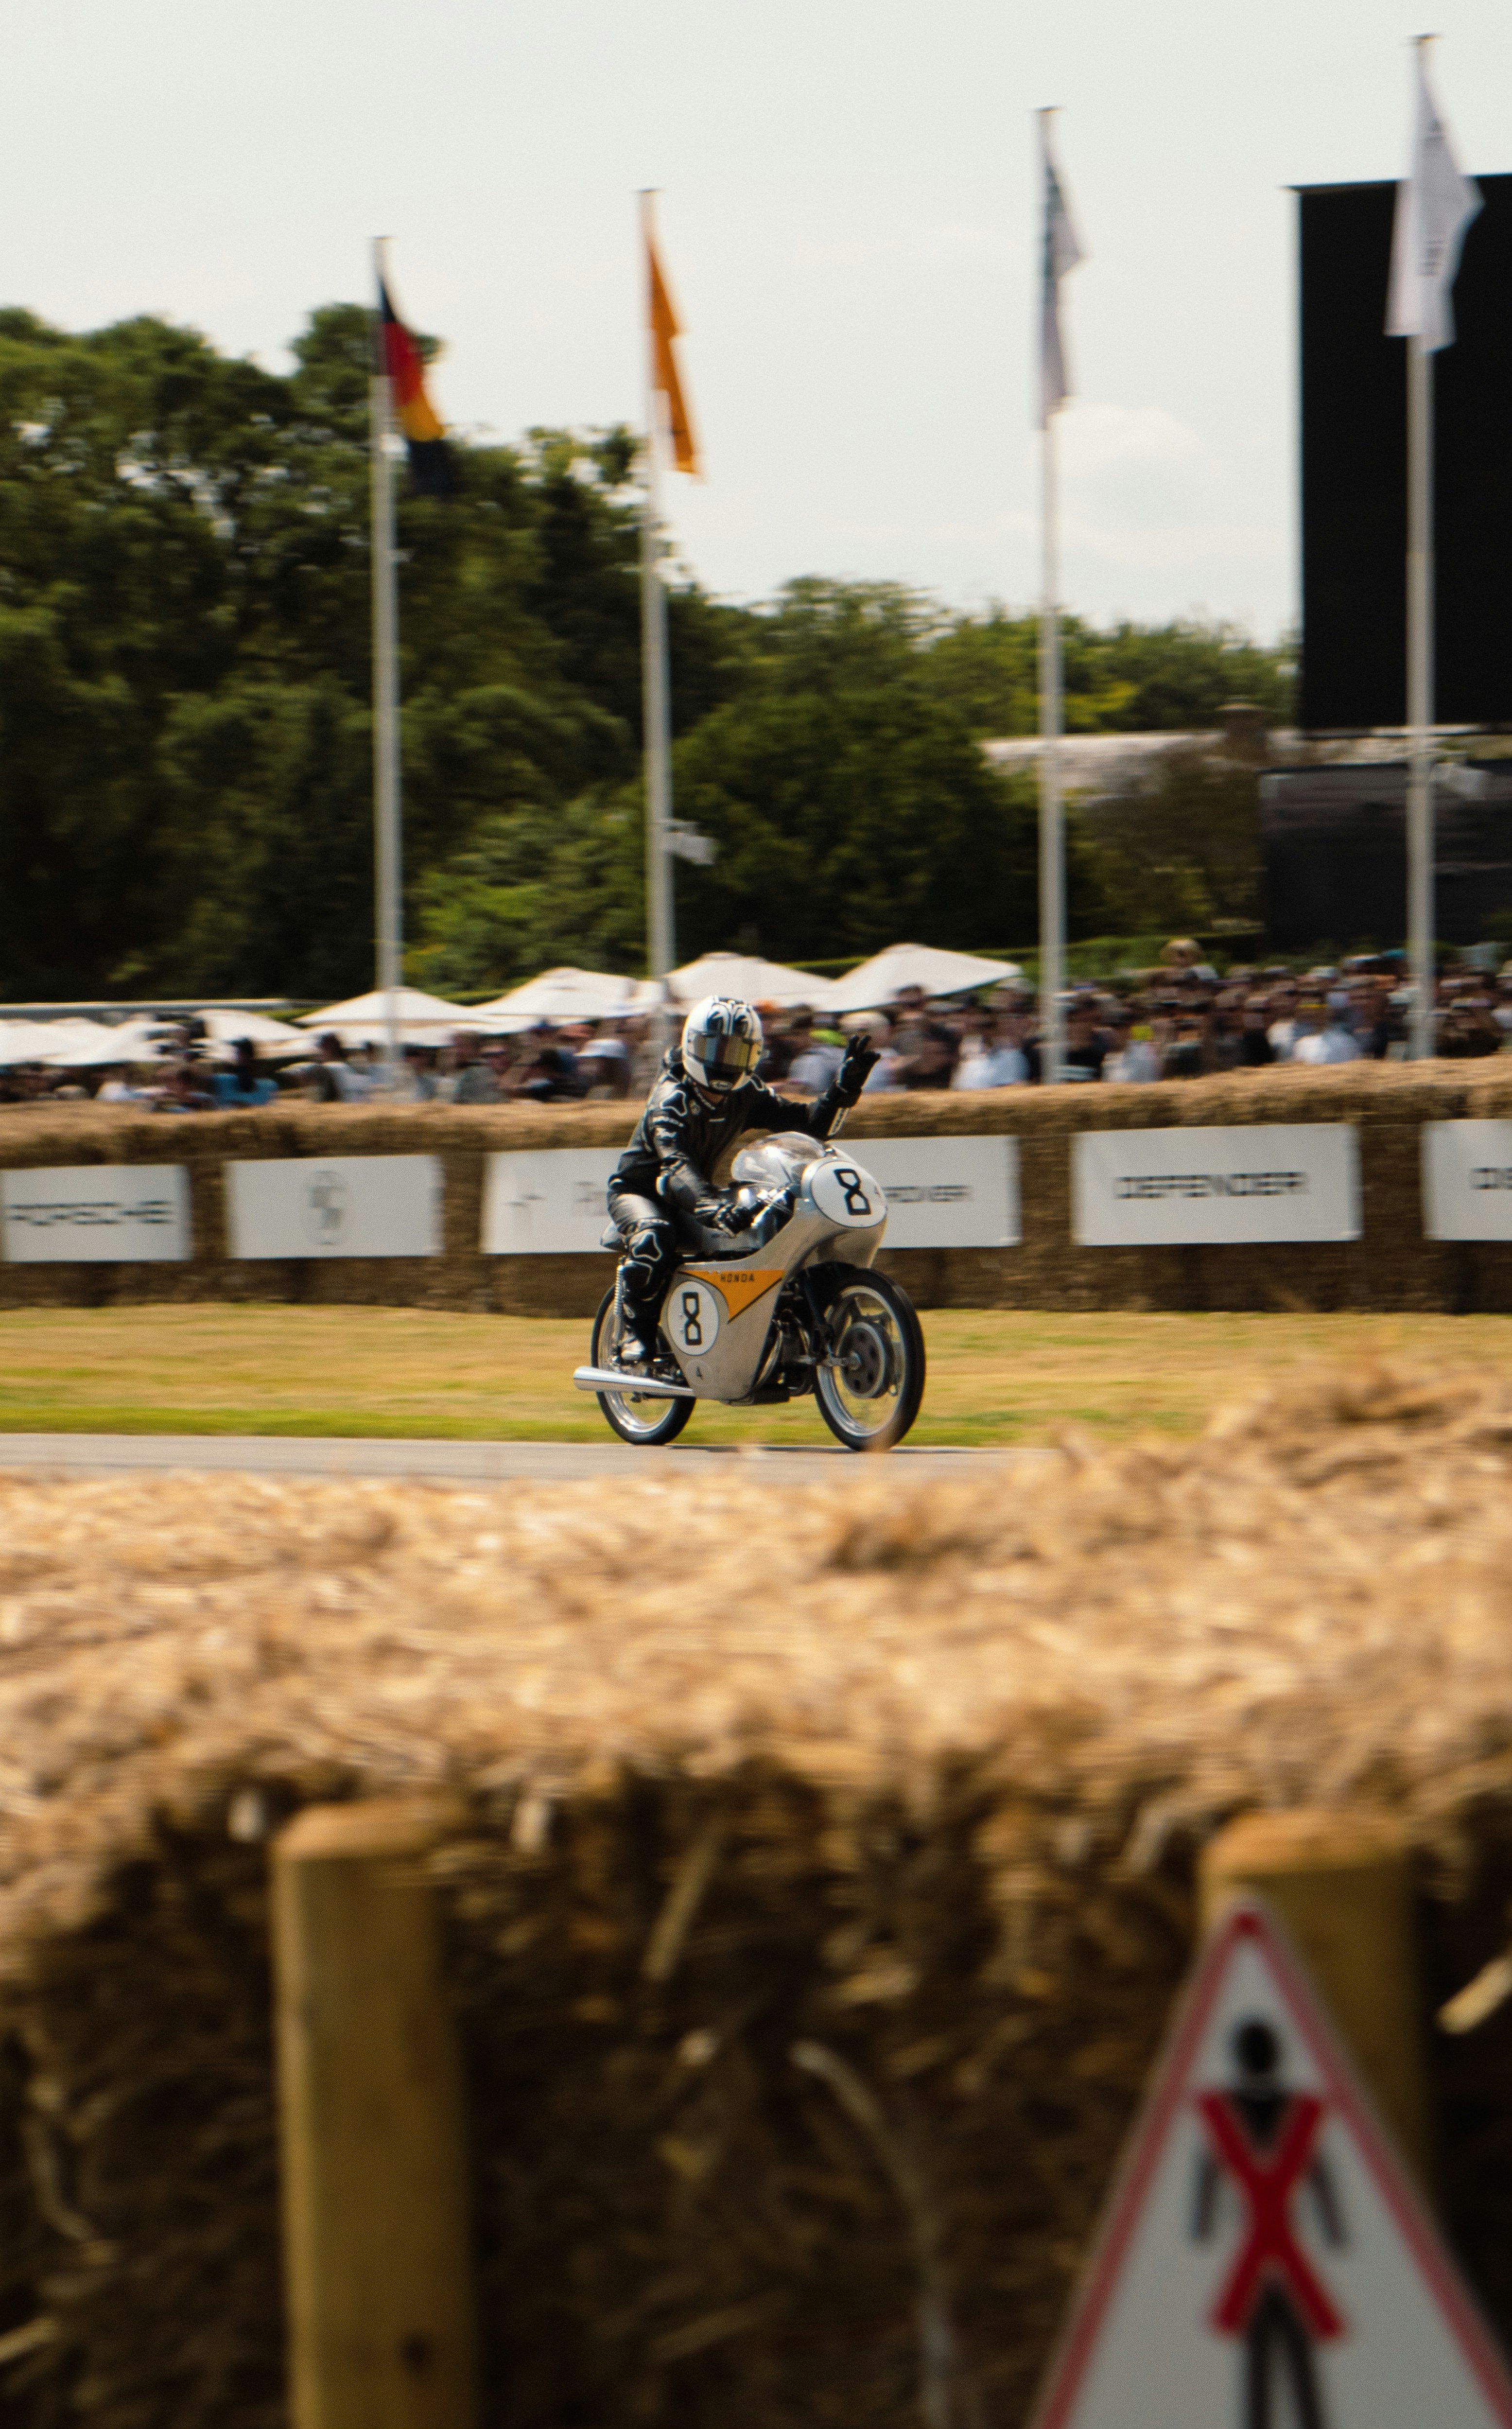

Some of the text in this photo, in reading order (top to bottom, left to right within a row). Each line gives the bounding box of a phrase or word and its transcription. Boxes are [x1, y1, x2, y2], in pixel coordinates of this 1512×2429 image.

[833, 1169, 871, 1215] 8
[720, 1273, 755, 1282] HONDA
[682, 1292, 702, 1346] 8
